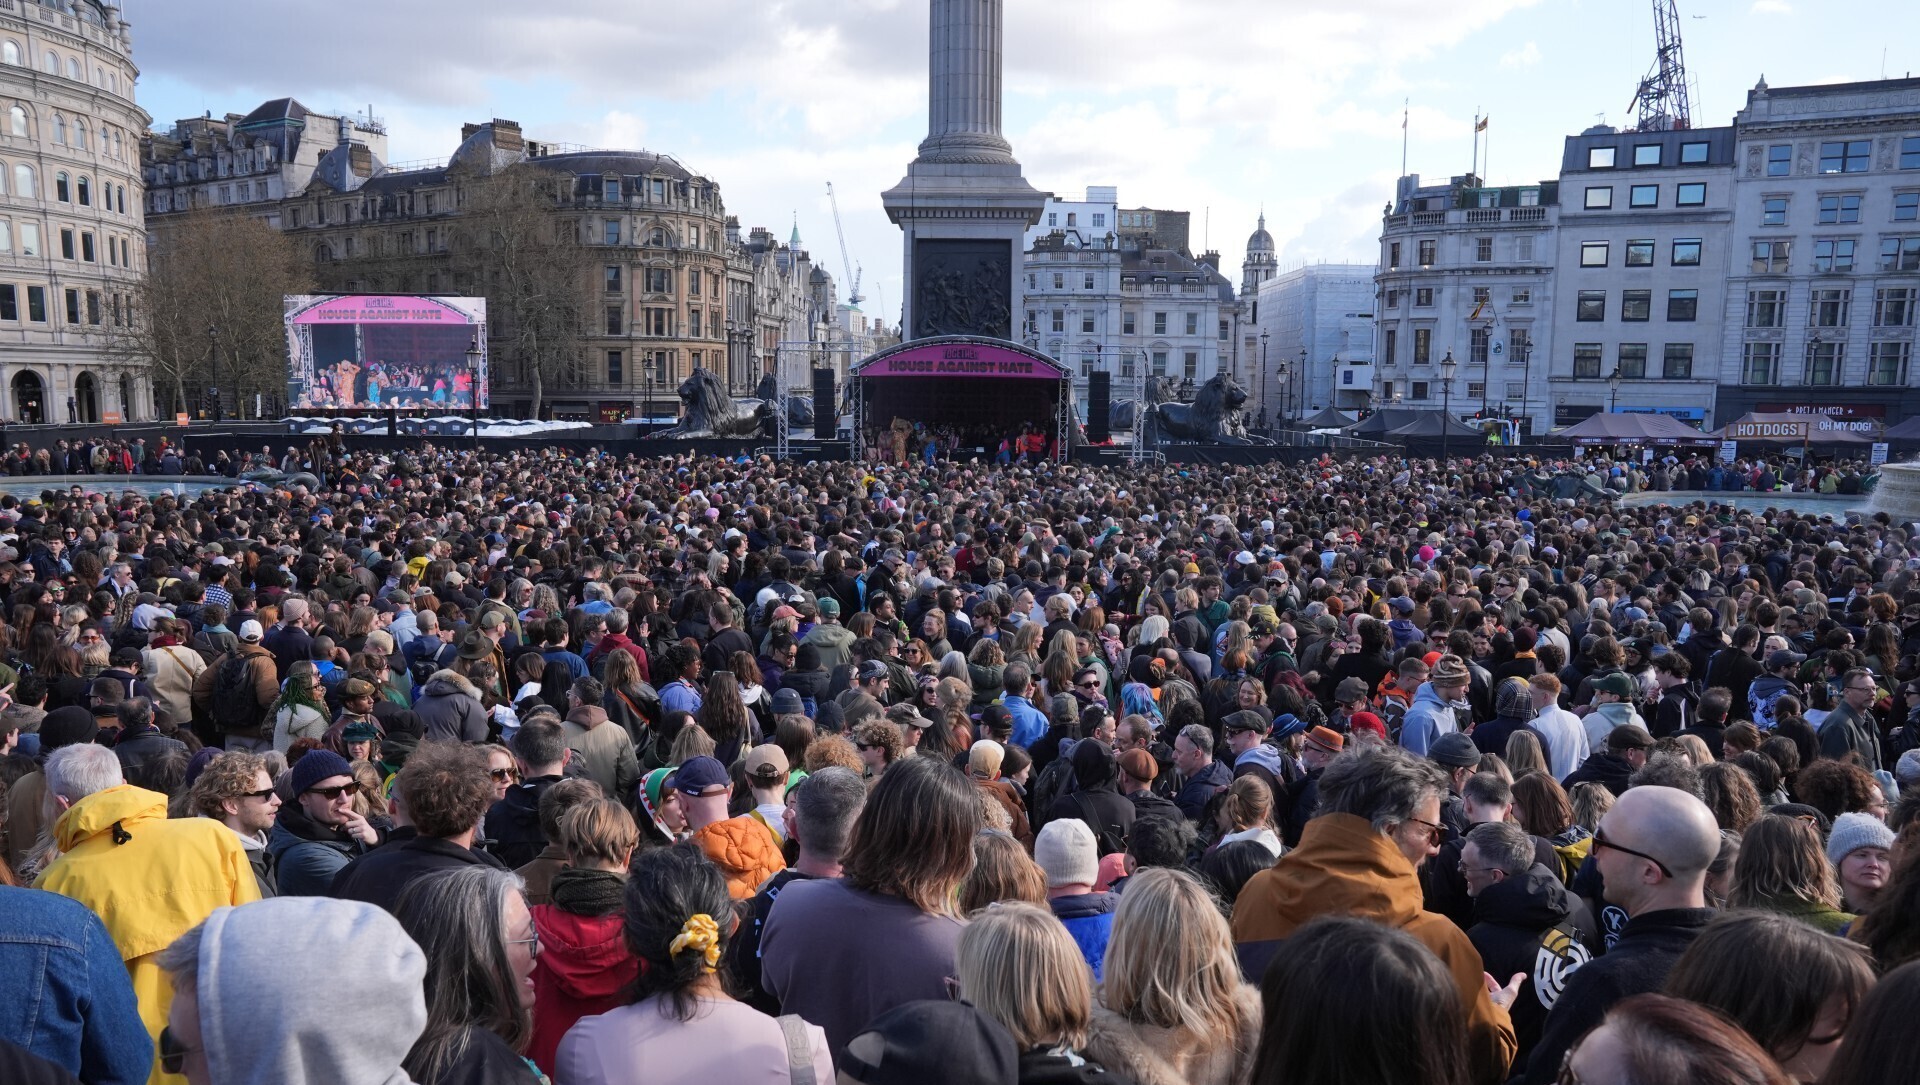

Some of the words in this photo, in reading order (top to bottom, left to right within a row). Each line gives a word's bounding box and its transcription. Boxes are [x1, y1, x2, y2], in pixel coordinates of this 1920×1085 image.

[1774, 96, 1858, 114] CANADIAN
[318, 309, 356, 320] HOUSE
[359, 309, 409, 320] AGAINST
[412, 309, 442, 320] HATE
[943, 348, 977, 359] TOGETHER
[888, 360, 933, 372] HOUSE
[936, 361, 995, 373] AGAINST
[998, 362, 1033, 374] HATE
[1795, 406, 1810, 414] PRET
[1818, 406, 1844, 415] MANGER
[1737, 423, 1798, 436] HOTDOGS
[1819, 421, 1832, 431] OH
[1833, 421, 1849, 431] MY
[1850, 422, 1872, 431] DOG!
